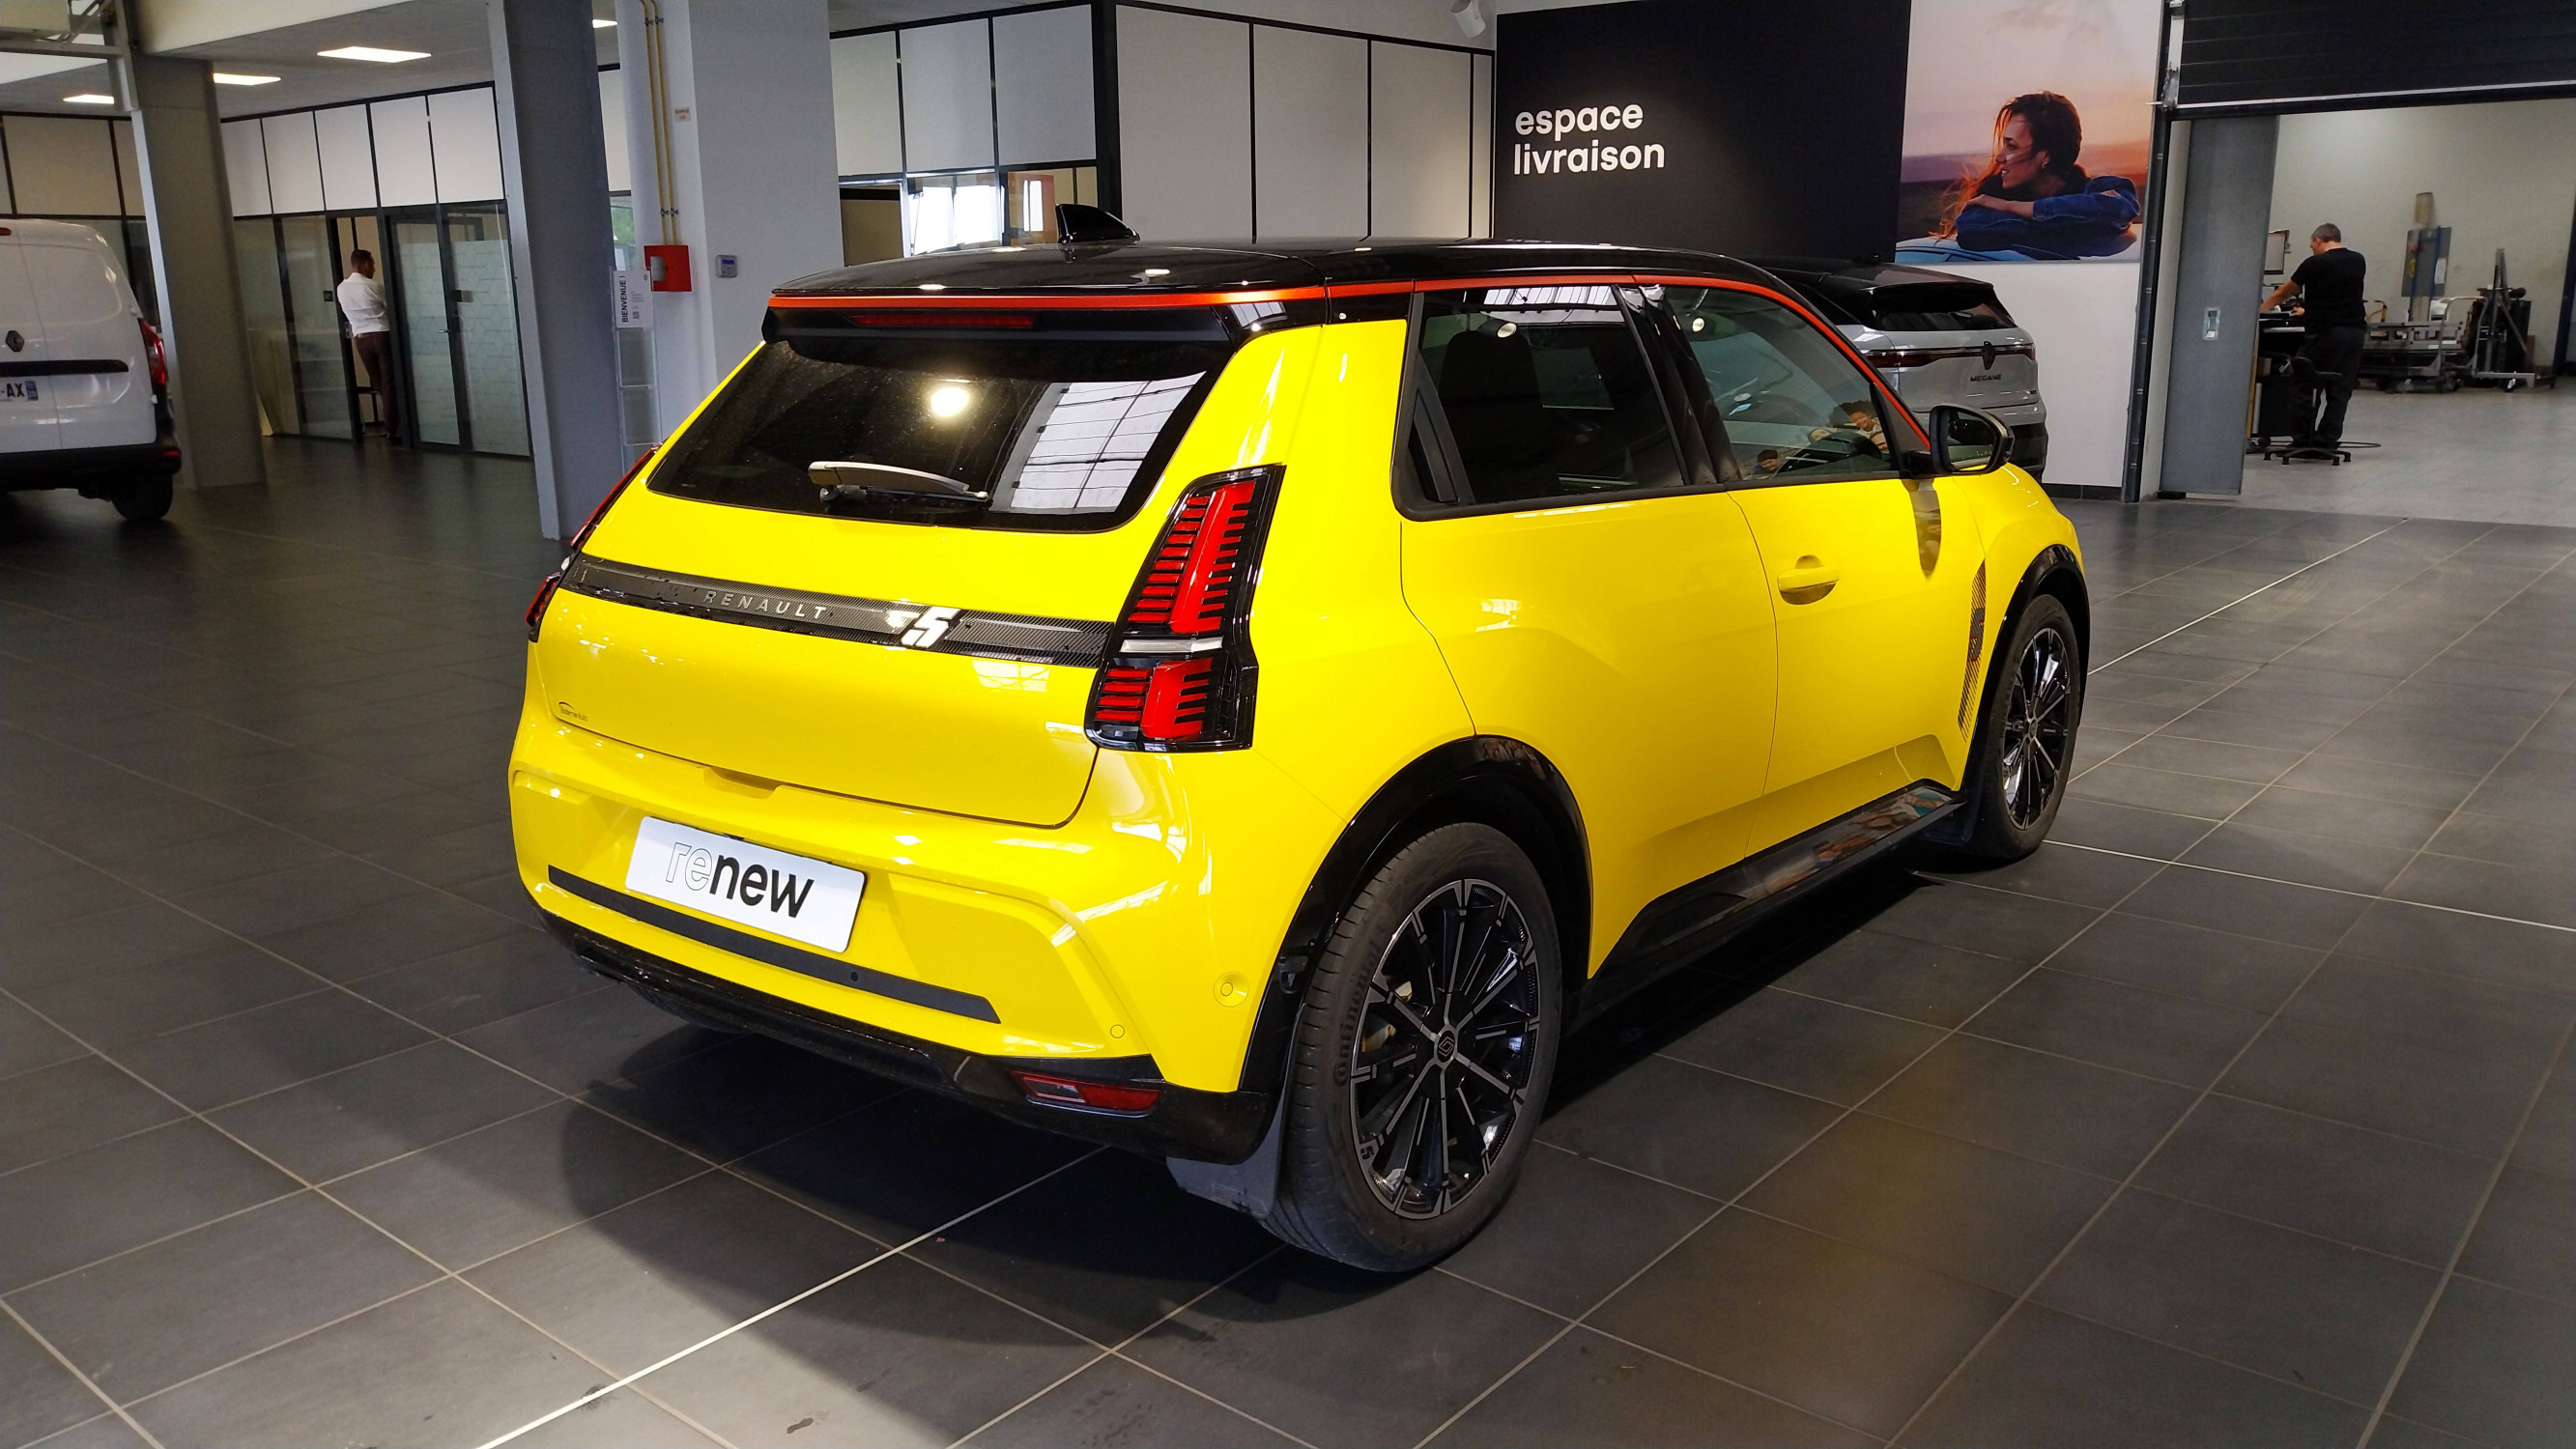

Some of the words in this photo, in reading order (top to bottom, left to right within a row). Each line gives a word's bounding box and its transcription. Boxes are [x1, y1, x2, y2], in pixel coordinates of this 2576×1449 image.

[1515, 103, 1644, 142] espace
[1514, 139, 1665, 175] livraison
[618, 280, 629, 323] BIENVENUE
[703, 590, 827, 620] RENAULT
[901, 606, 961, 648] 5
[665, 841, 816, 919] renew
